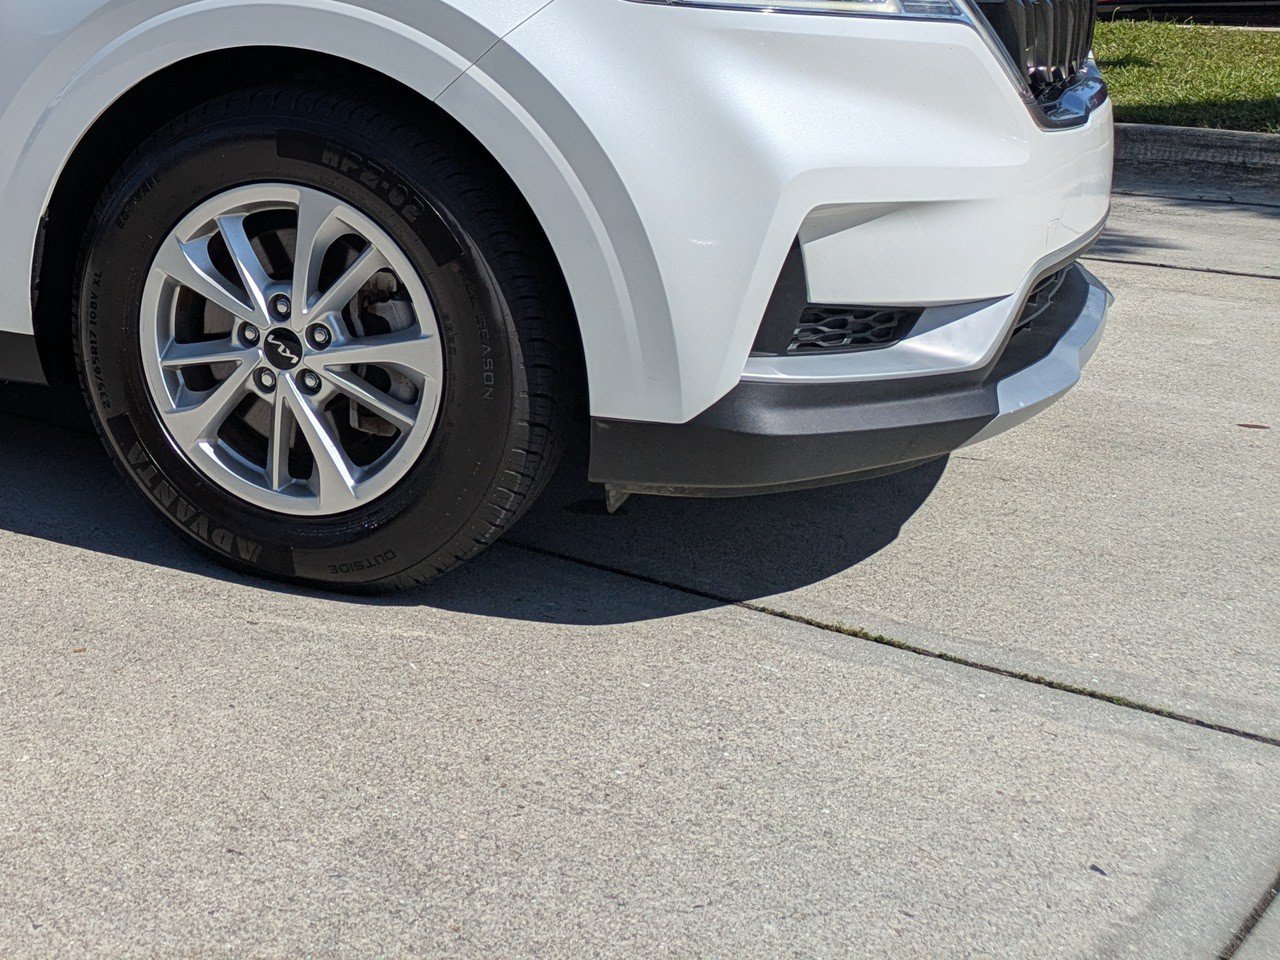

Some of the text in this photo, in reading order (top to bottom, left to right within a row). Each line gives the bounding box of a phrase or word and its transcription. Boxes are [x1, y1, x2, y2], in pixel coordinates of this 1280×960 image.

[474, 315, 496, 399] SEASON
[127, 441, 262, 563] ADVANTA
[327, 549, 397, 574] OUTSIDE
